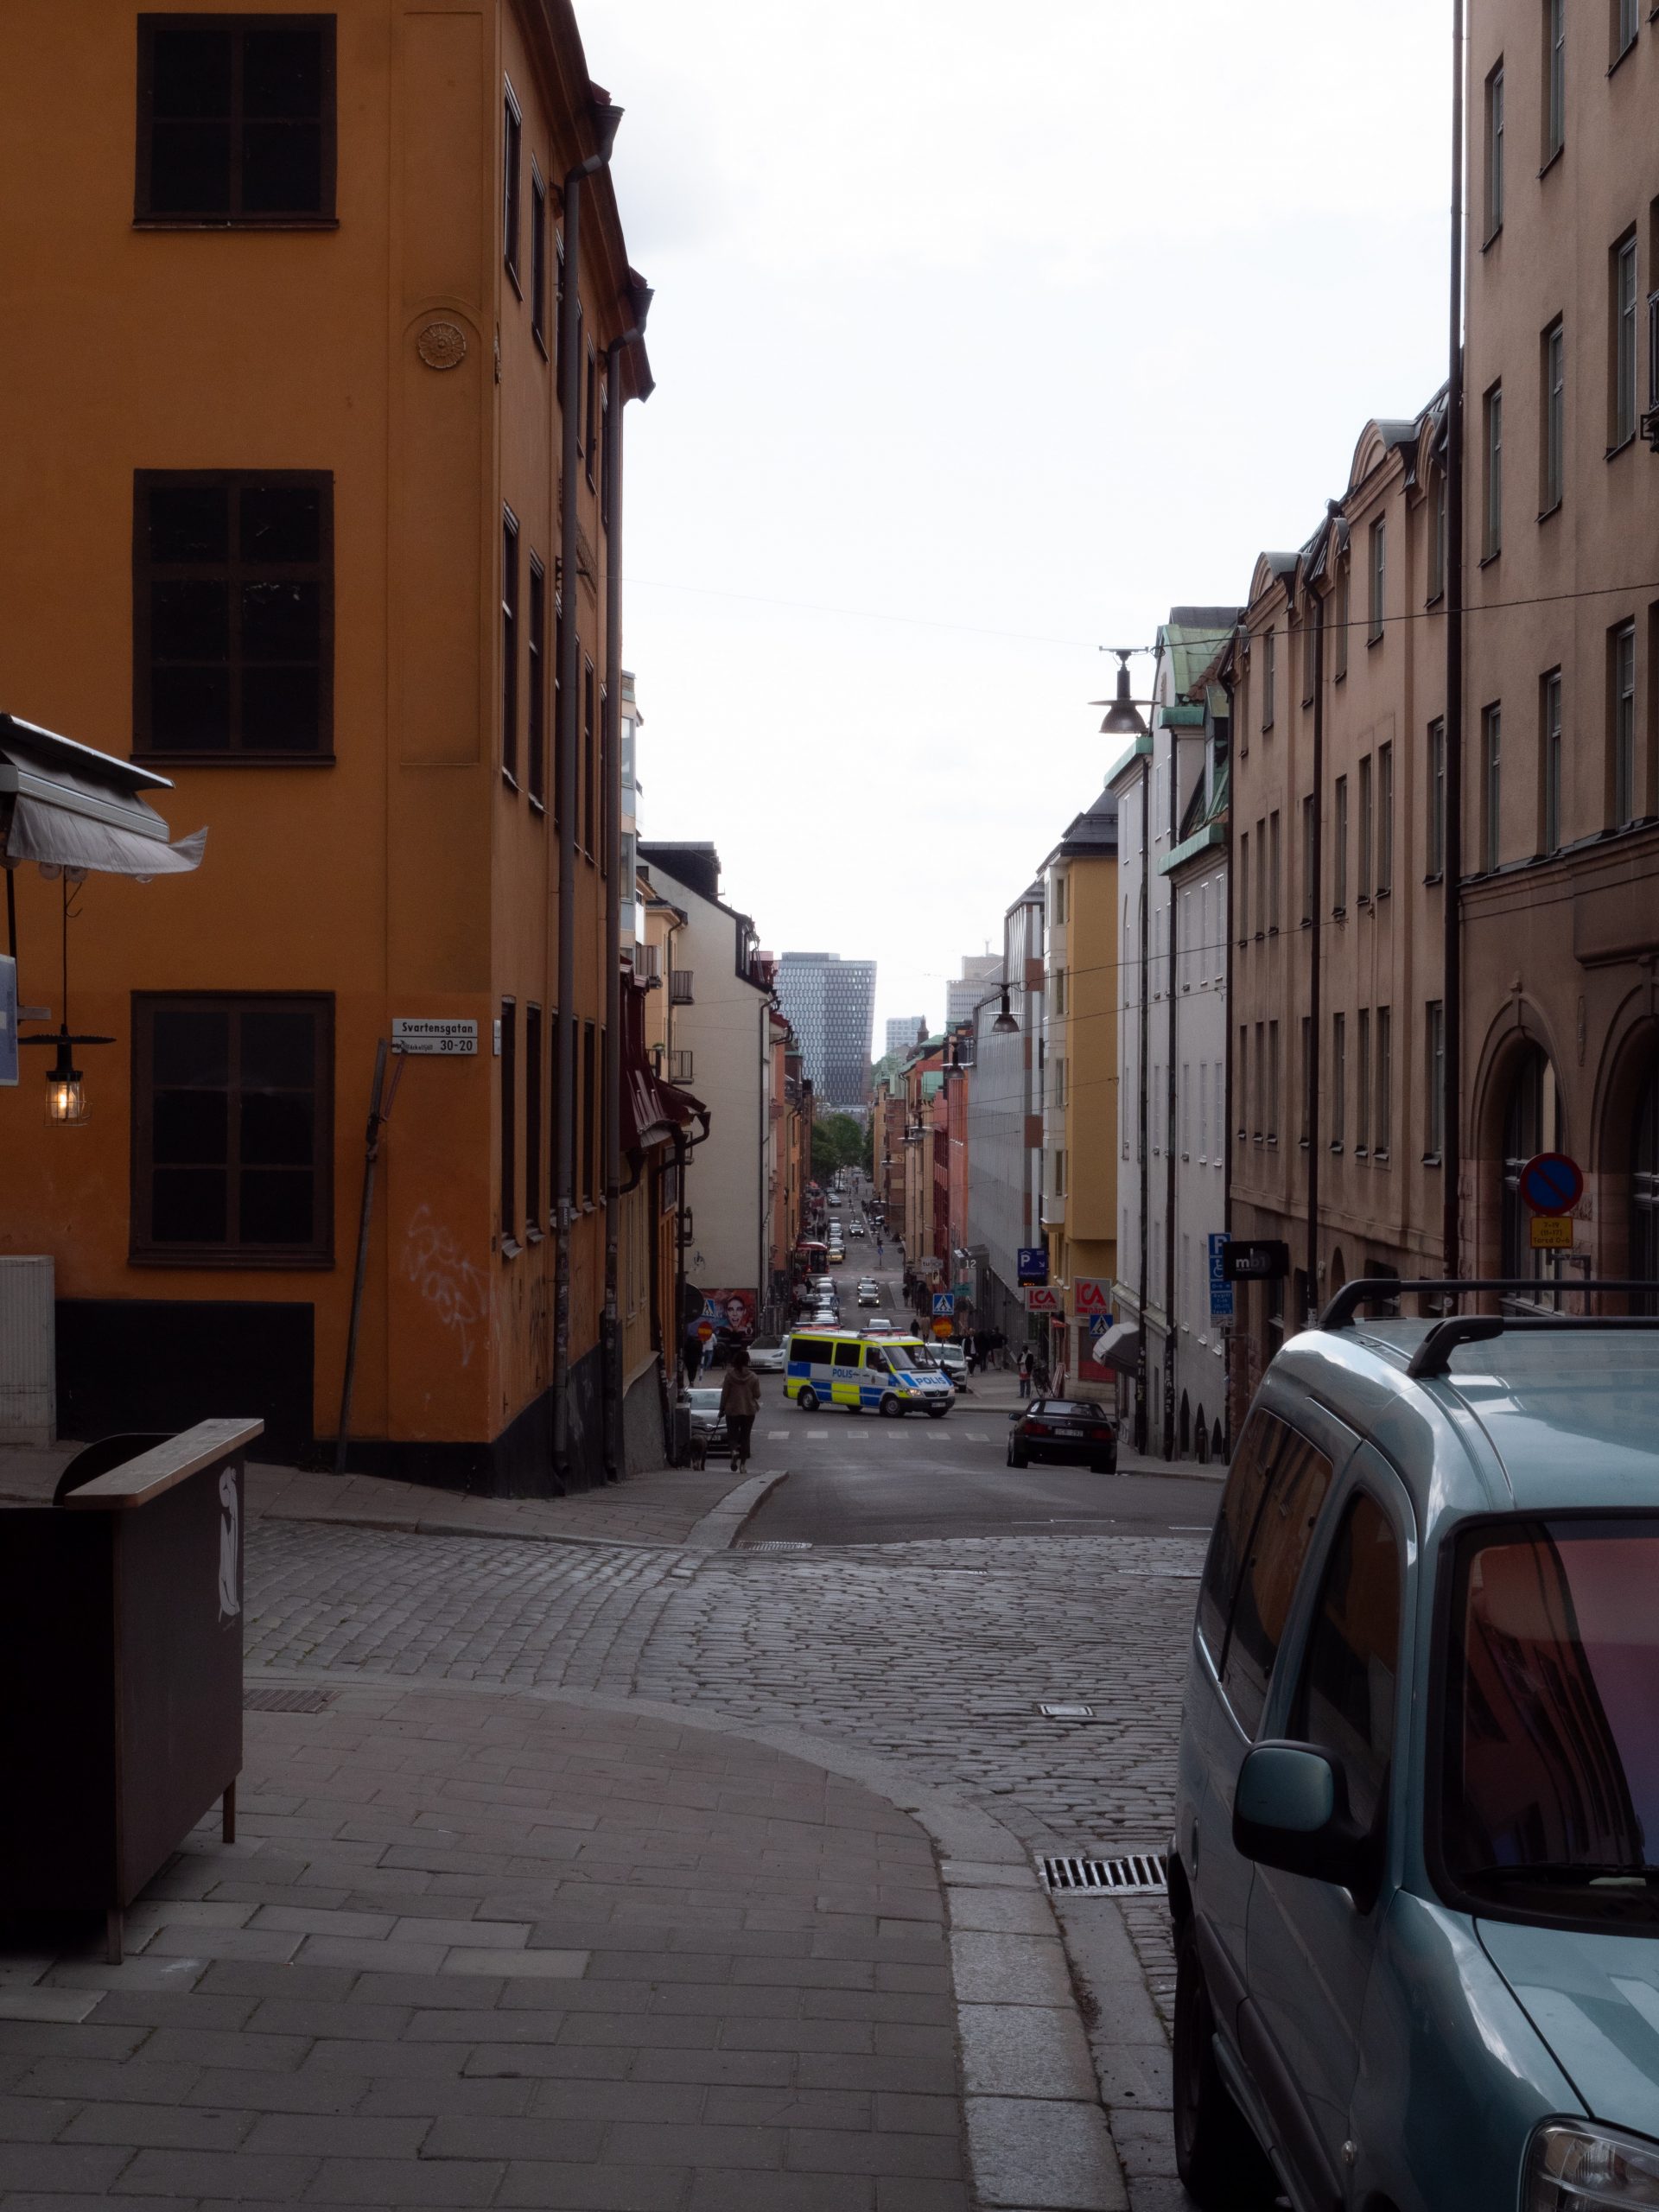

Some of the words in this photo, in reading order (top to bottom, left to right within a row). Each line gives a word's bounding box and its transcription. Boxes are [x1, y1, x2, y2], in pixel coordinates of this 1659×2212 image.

[402, 1022, 473, 1035] Svartensgatan
[440, 1040, 473, 1052] 30-20
[965, 1259, 976, 1269] 12
[1020, 1255, 1031, 1268] P
[1029, 1291, 1056, 1303] ICA
[1077, 1283, 1106, 1306] ICA
[832, 1368, 853, 1379] POLIS
[916, 1376, 947, 1386] POLIS
